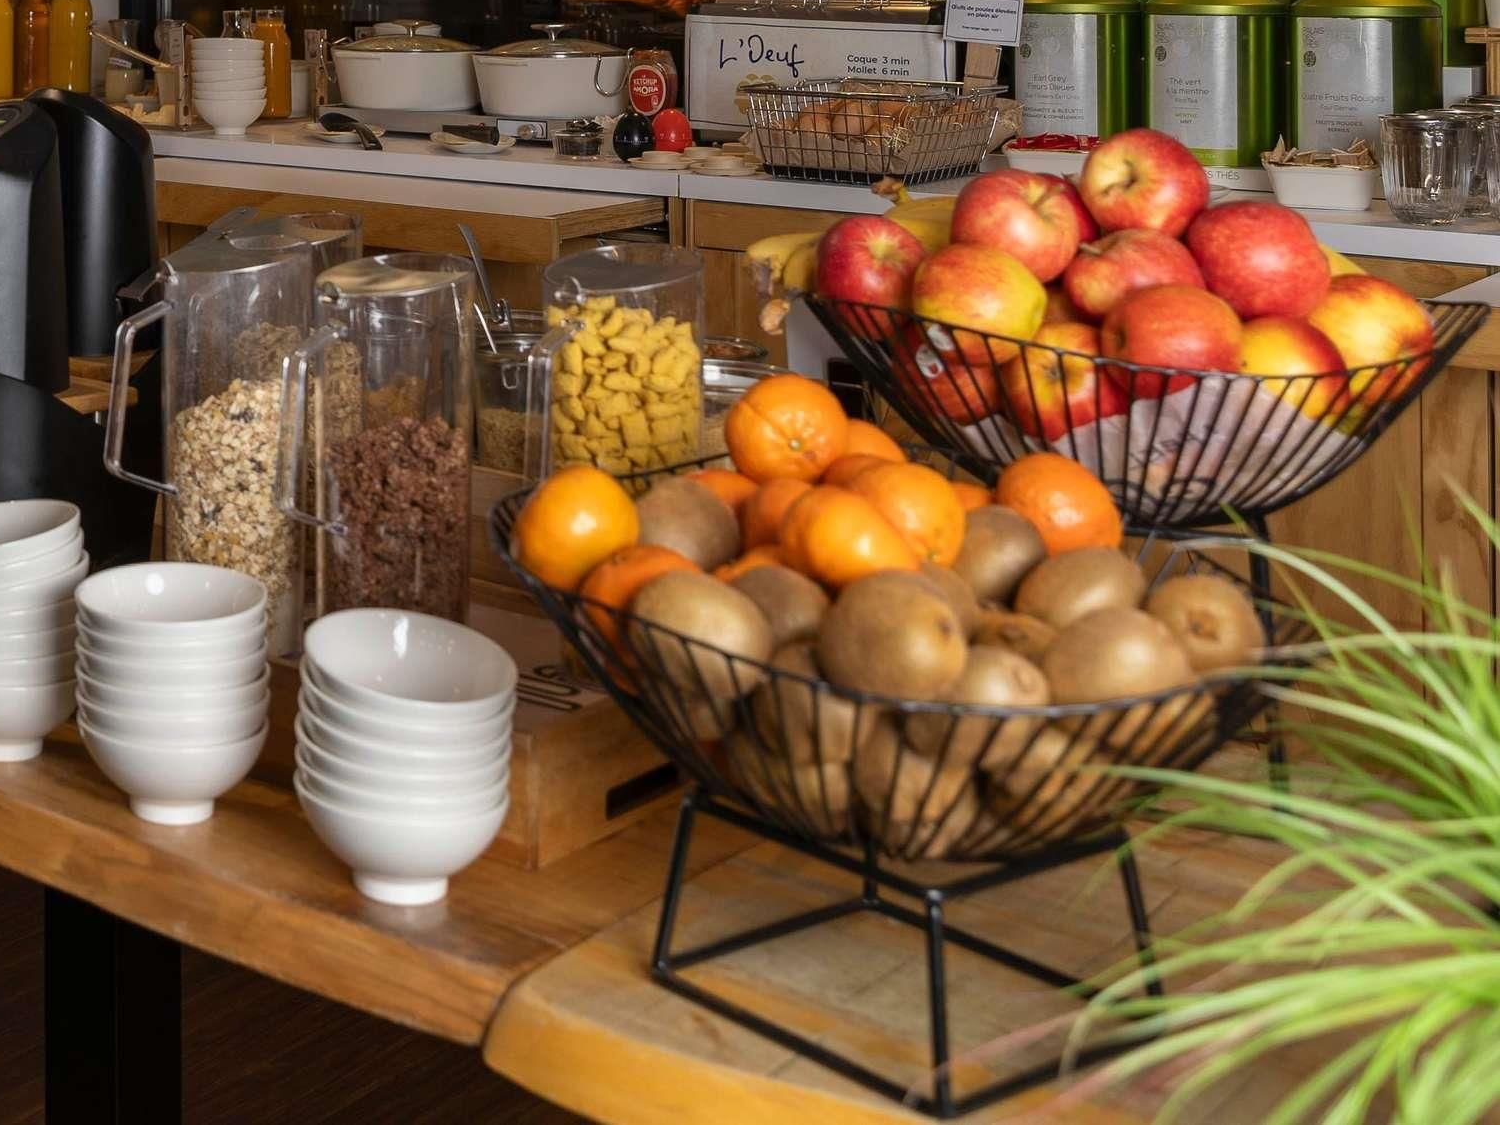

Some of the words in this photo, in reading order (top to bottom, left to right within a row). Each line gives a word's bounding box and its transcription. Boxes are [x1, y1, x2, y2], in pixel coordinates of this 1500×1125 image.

[719, 34, 805, 78] L'Oeuf
[847, 54, 878, 65] Coque
[882, 55, 888, 64] 3
[890, 55, 910, 66] min
[847, 65, 877, 75] Mollet
[881, 66, 888, 75] 6
[890, 66, 910, 76] min
[633, 86, 659, 94] AMORA
